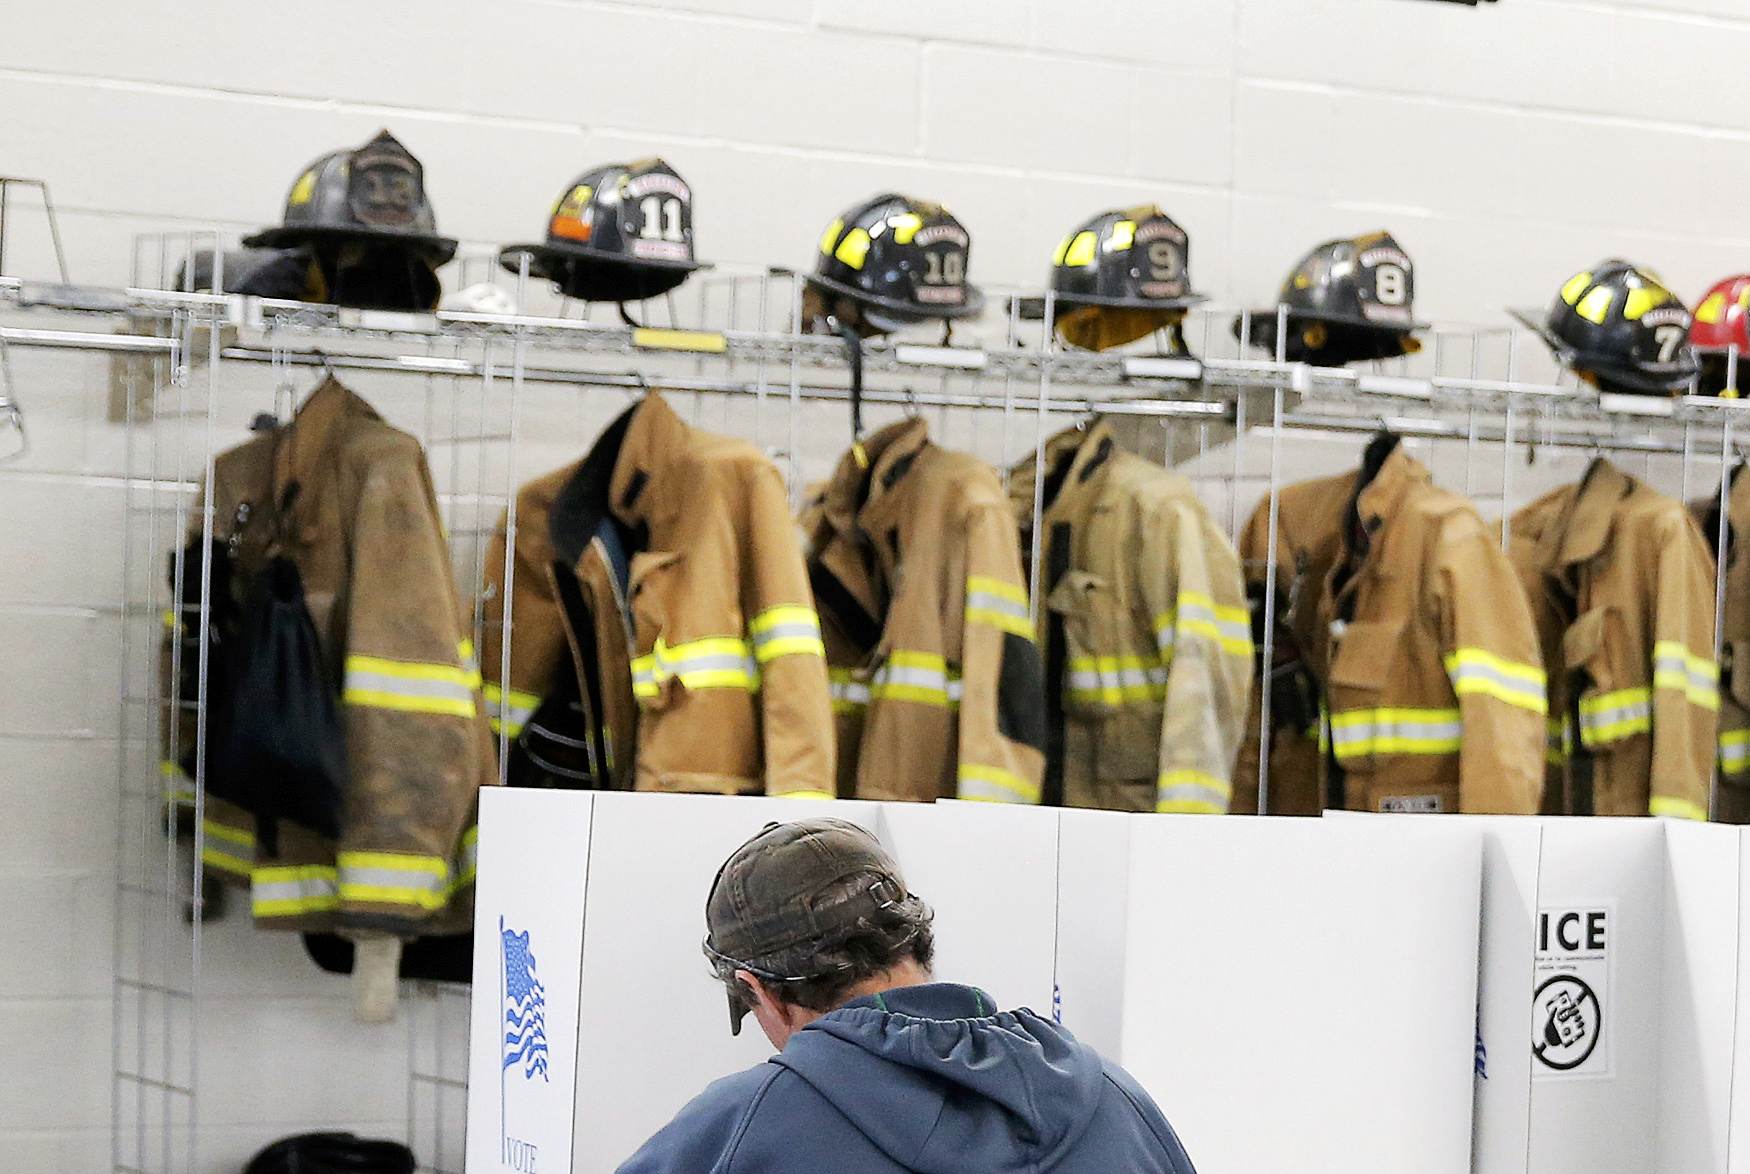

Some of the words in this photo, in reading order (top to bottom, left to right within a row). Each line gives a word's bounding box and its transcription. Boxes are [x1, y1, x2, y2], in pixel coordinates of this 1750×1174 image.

[640, 196, 684, 242] 11
[923, 251, 965, 285] 10
[1148, 241, 1178, 281] 9
[1375, 265, 1406, 305] 8
[1655, 325, 1686, 362] 7
[1539, 912, 1606, 951] ICE
